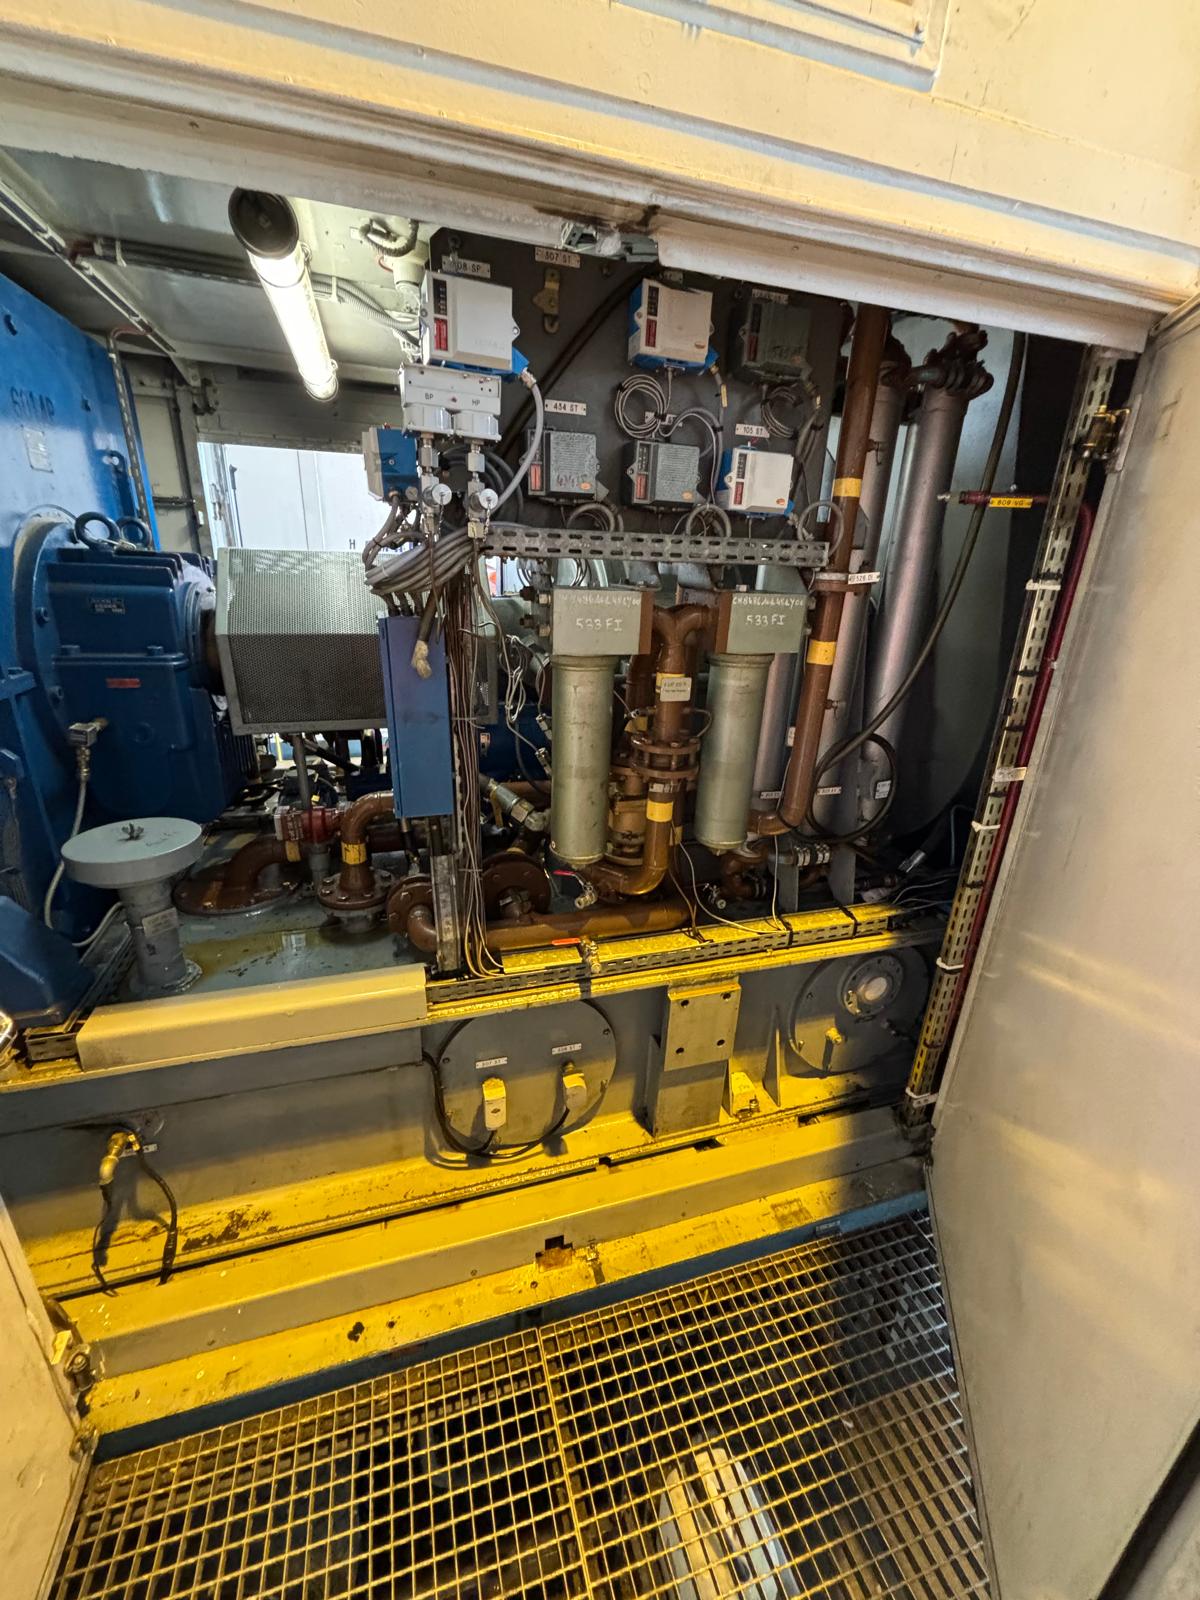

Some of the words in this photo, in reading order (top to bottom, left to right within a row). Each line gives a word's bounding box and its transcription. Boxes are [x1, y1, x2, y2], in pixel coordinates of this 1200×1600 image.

[570, 404, 578, 413] ST
[575, 617, 602, 631] 533
[605, 617, 623, 632] FI
[745, 614, 769, 627] 533
[771, 613, 786, 626] FI
